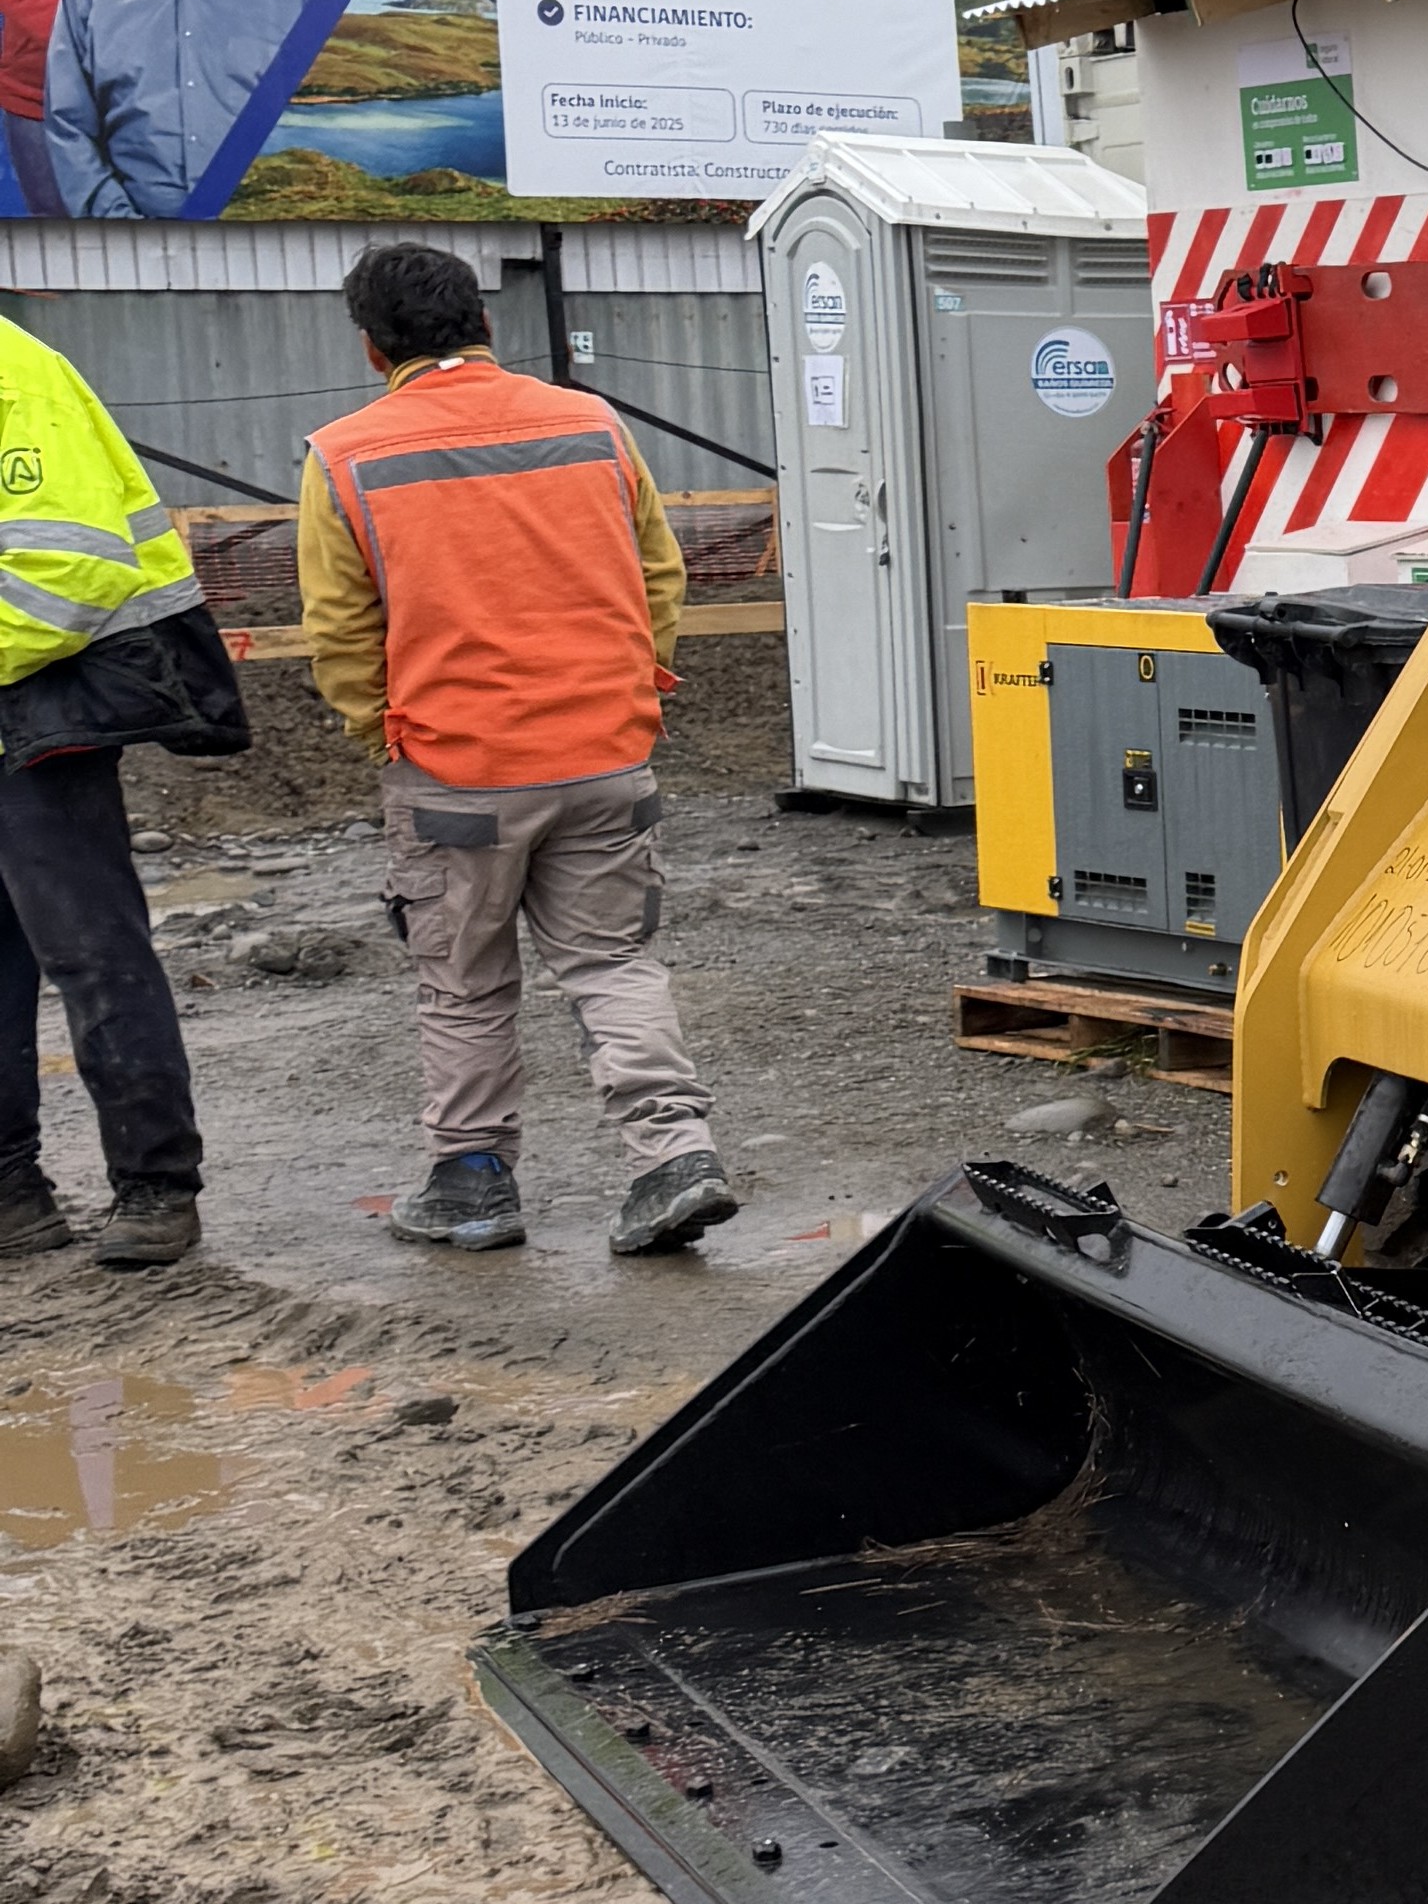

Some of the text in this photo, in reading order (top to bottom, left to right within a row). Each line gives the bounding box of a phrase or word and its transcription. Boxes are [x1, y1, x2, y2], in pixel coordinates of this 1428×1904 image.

[573, 4, 754, 30] FINANCIAMIENTO:
[574, 30, 624, 45] Público
[637, 33, 687, 48] Privado
[550, 94, 595, 108] Fecha
[762, 100, 899, 122] Plazo de ejecución:
[552, 114, 568, 128] 13
[573, 115, 590, 129] de
[629, 117, 647, 130] de
[650, 117, 684, 131] 2025
[763, 120, 788, 134] 730
[603, 159, 699, 178] Contratista:
[1052, 360, 1110, 375] ersan
